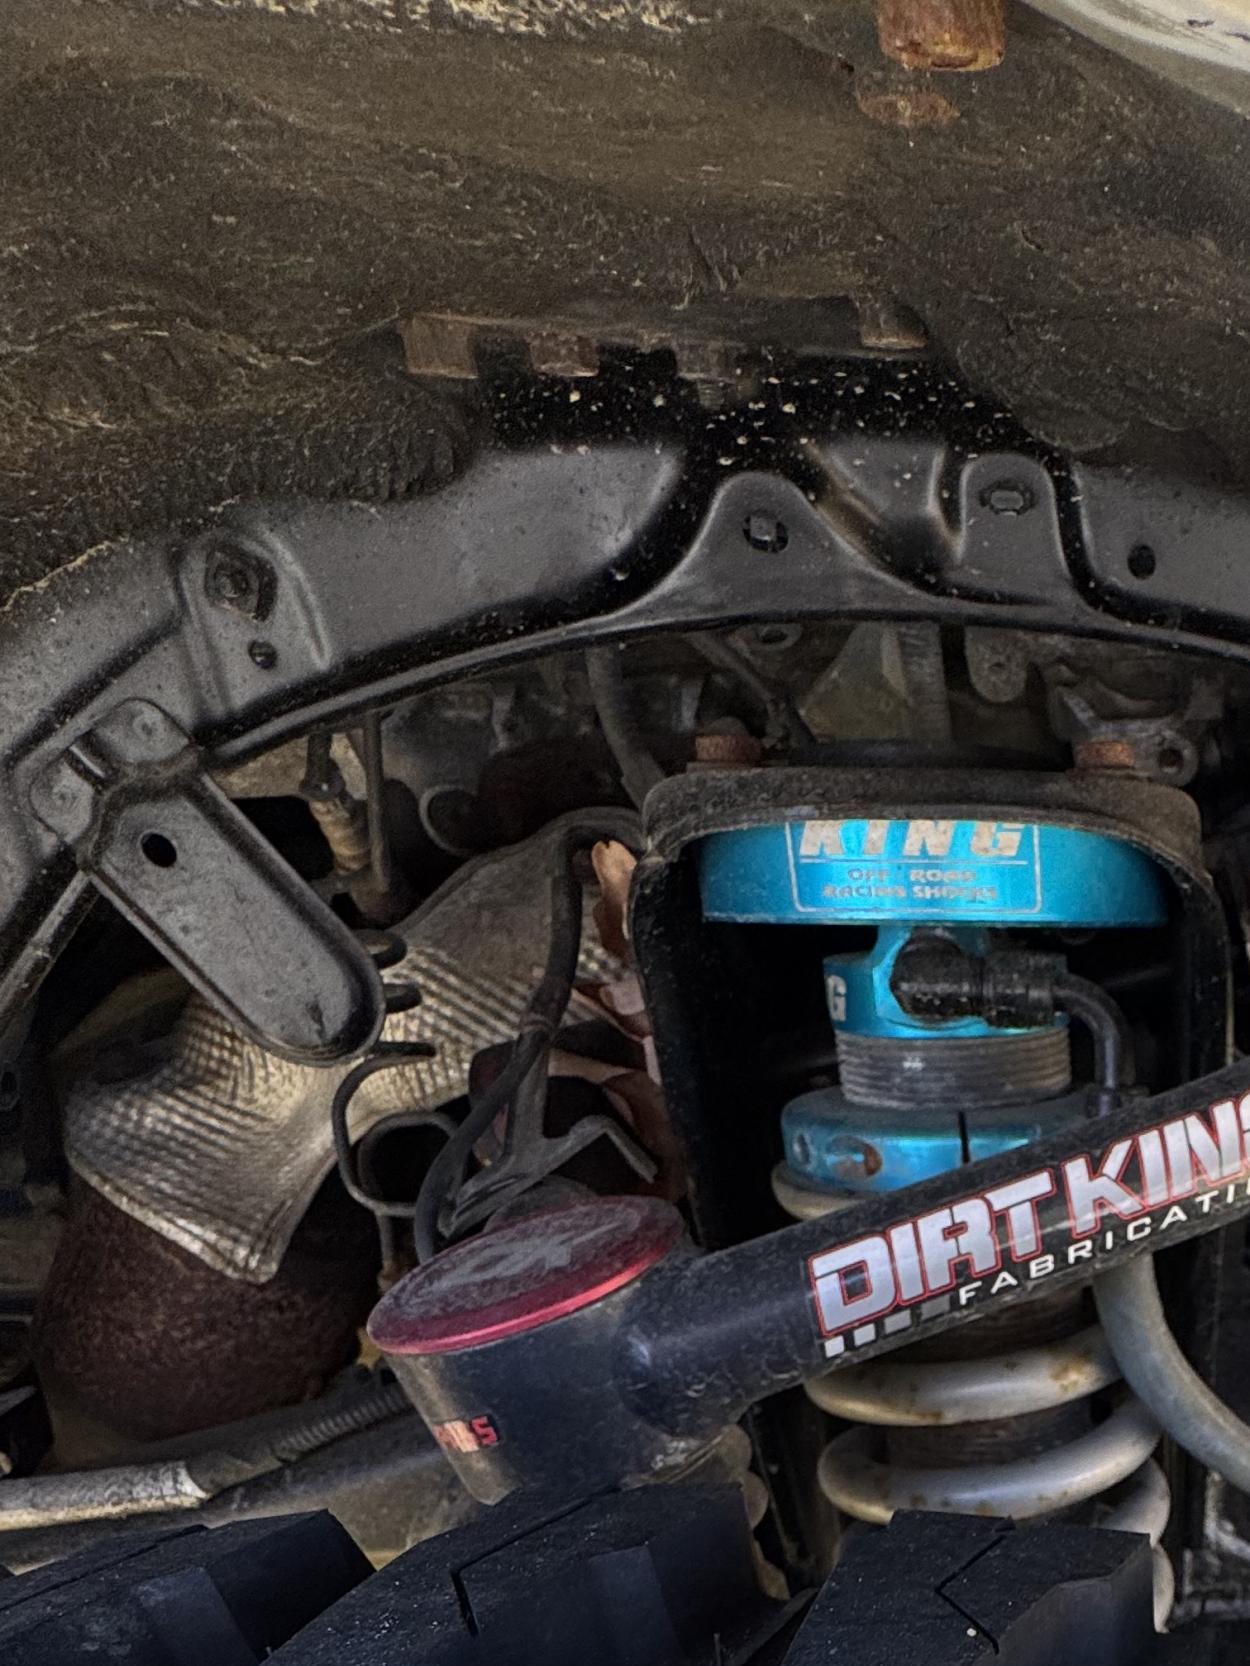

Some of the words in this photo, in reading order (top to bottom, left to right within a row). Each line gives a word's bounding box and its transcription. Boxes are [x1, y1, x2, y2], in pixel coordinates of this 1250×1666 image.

[800, 819, 1025, 857] KING
[823, 885, 907, 899] RACING
[912, 885, 998, 900] SHOCKS
[809, 1166, 1056, 1336] DIRT
